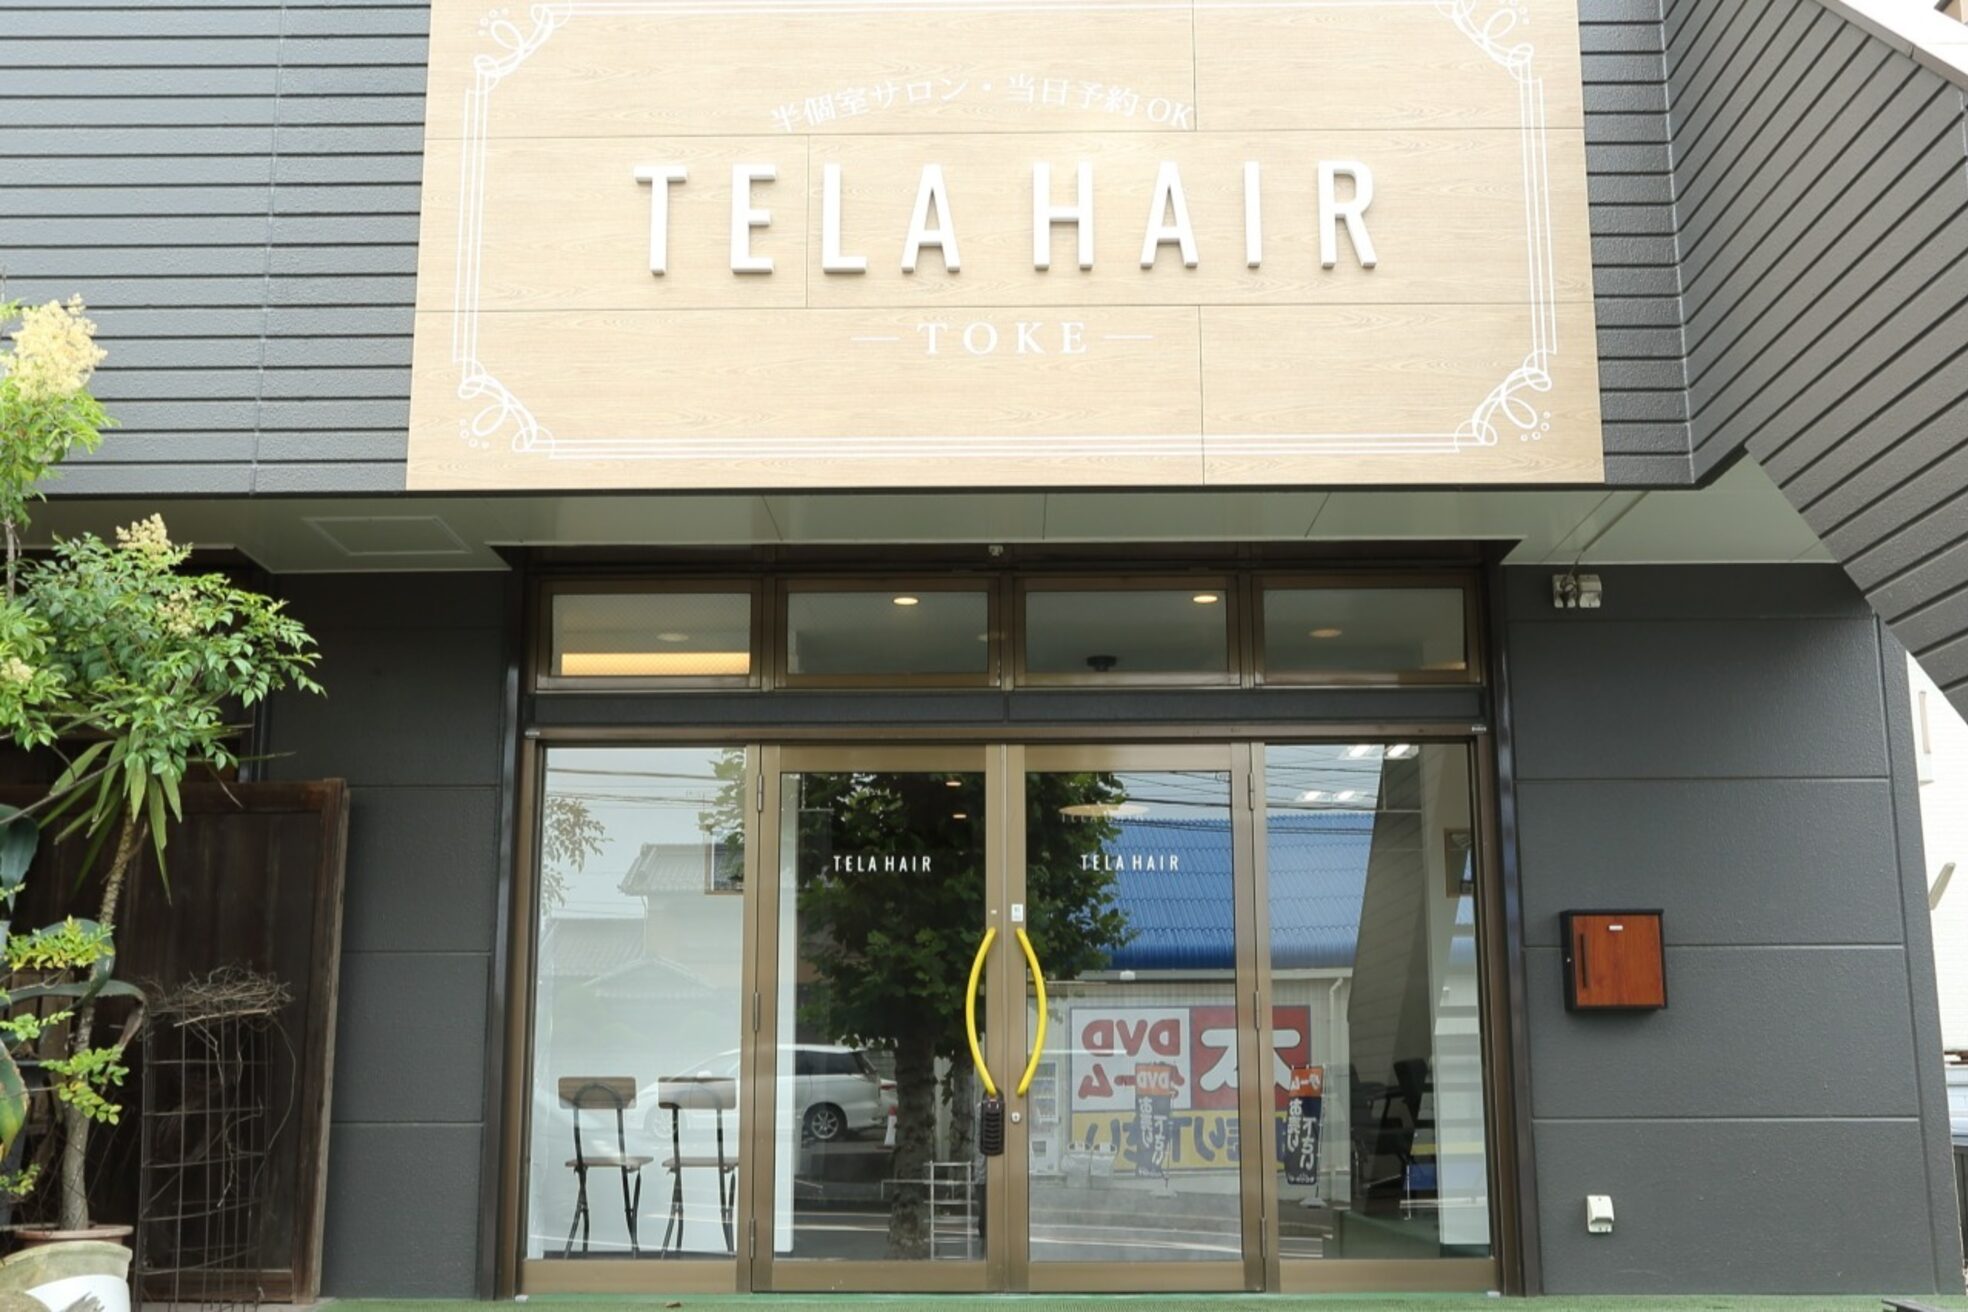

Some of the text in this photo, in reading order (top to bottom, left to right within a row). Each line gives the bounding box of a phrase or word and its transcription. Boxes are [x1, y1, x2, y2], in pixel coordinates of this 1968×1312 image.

[633, 159, 1378, 277] TELA HAIR
[917, 320, 1087, 355] TOKE
[833, 855, 933, 873] TELA HAIR
[1080, 854, 1180, 872] TELA HAIR
